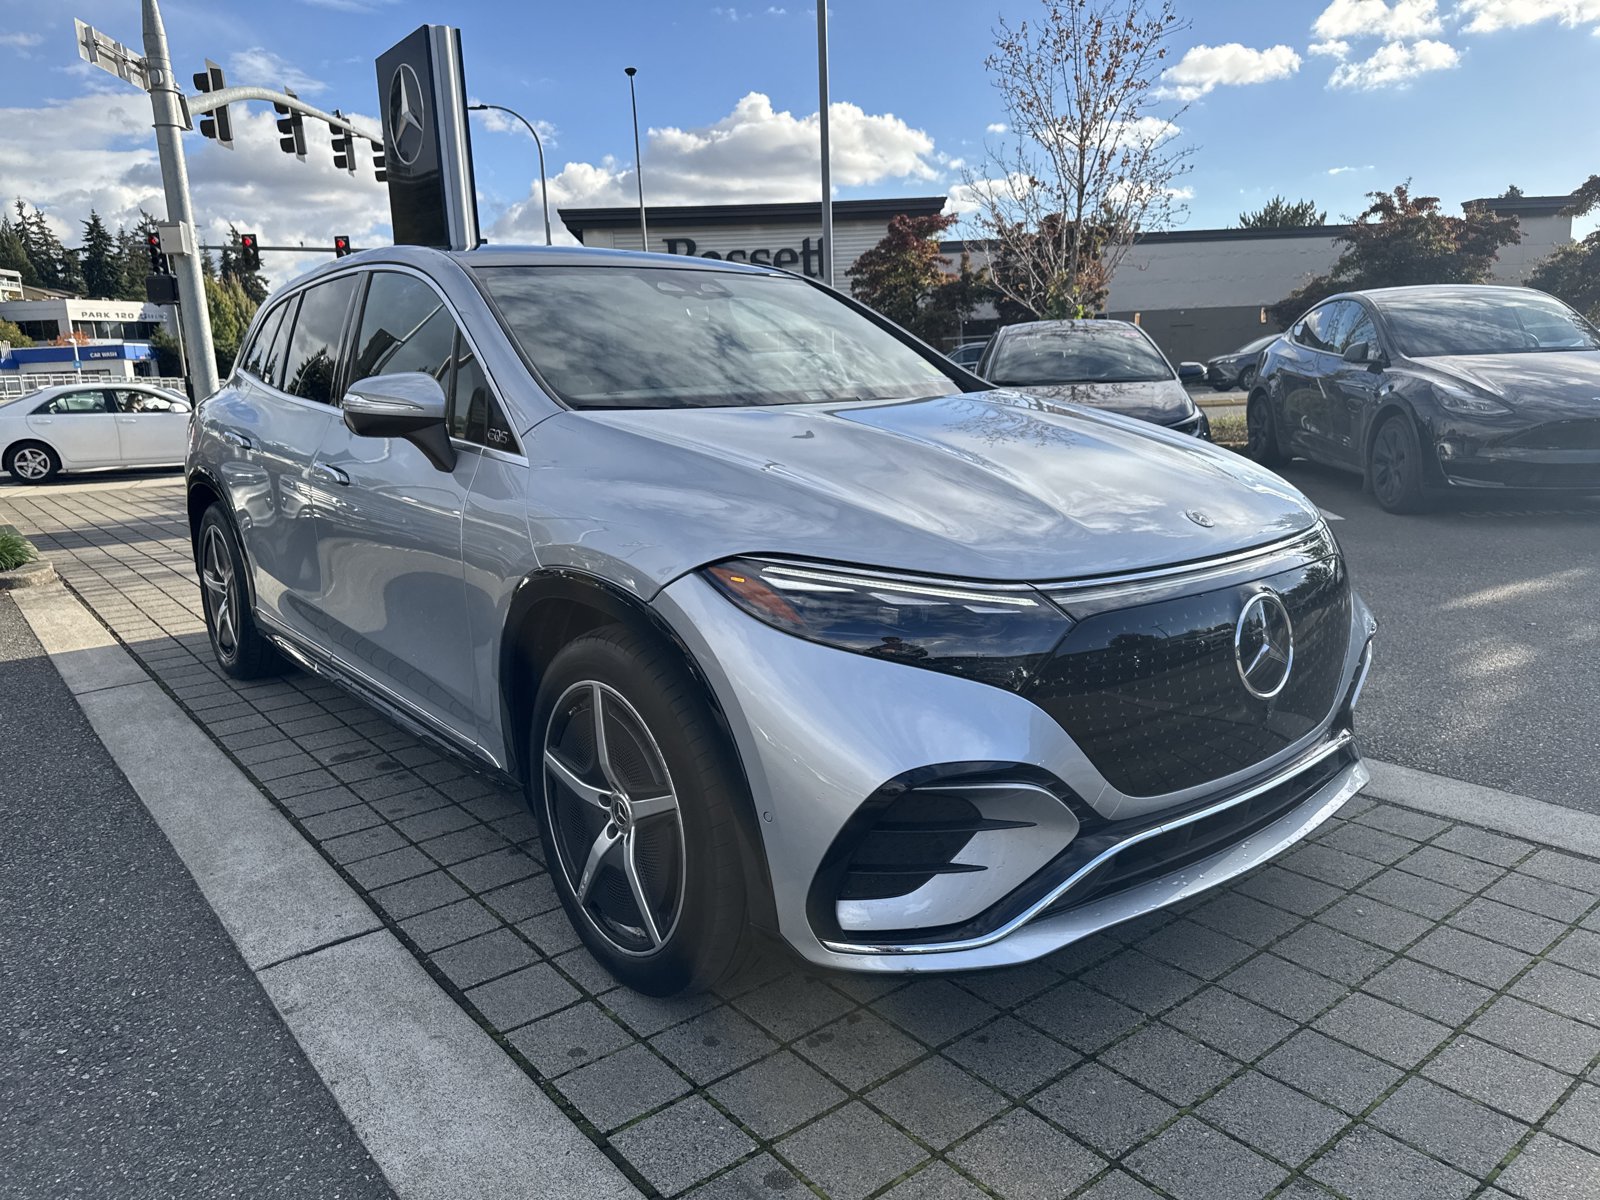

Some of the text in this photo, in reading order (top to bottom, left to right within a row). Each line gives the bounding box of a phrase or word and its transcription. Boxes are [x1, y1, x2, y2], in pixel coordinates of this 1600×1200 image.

[662, 237, 824, 278] sett
[81, 311, 110, 319] PARK
[487, 428, 509, 444] EQS
